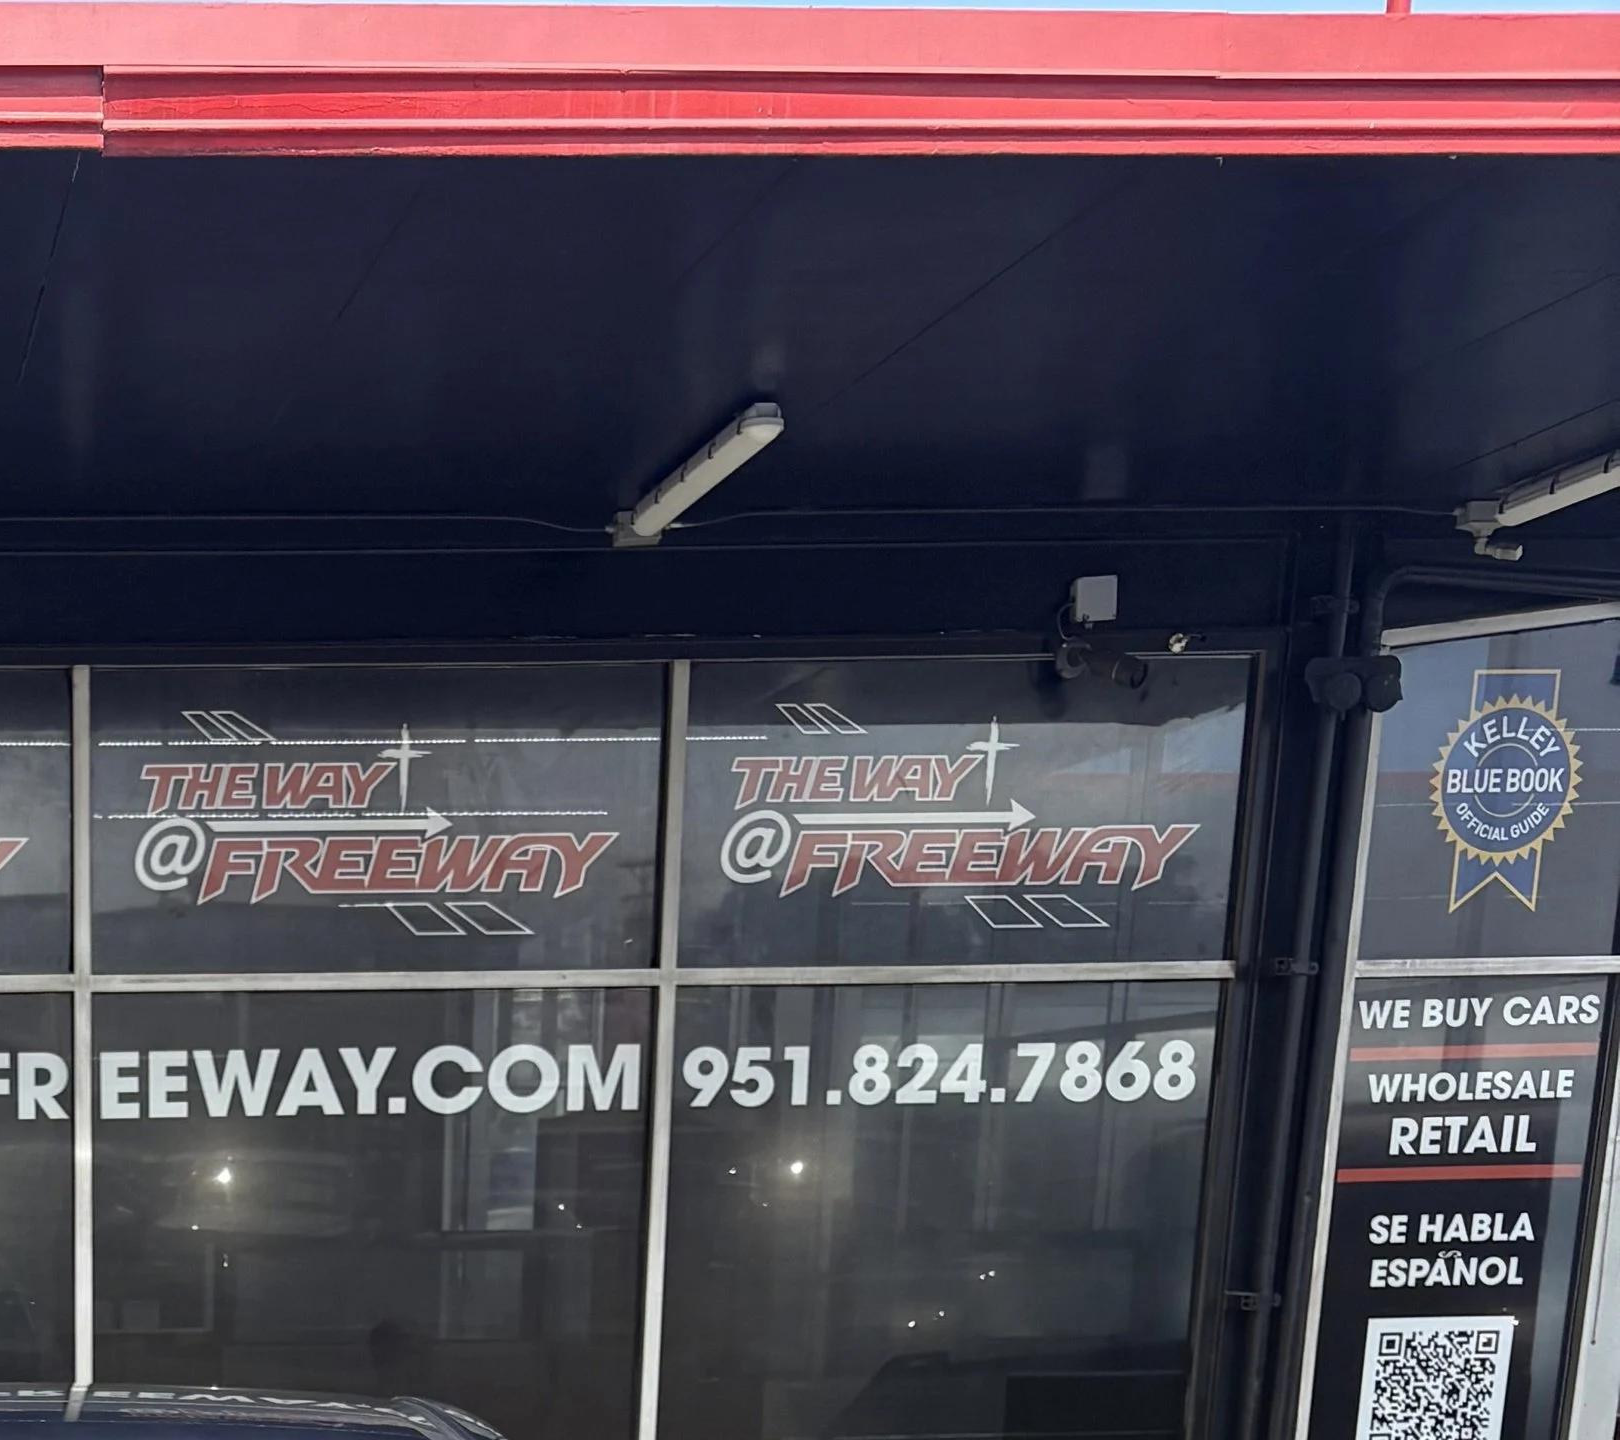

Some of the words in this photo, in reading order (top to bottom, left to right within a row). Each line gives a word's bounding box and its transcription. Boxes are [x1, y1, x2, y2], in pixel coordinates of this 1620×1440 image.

[1463, 715, 1561, 758] KELLEY
[1446, 768, 1503, 794] BLUE
[1505, 767, 1565, 793] BOOK
[1456, 802, 1509, 841] OFFICIAL
[1509, 802, 1550, 838] GUIDE
[1359, 1000, 1412, 1029] WE
[1421, 997, 1494, 1028] BUY
[1502, 994, 1601, 1026] CARS
[682, 1040, 1197, 1108] 951.824.7868
[1367, 1069, 1575, 1103] WHOLESALE
[1389, 1114, 1537, 1156] RETAIL
[1368, 1214, 1409, 1245] SE
[1417, 1212, 1535, 1243] HABLA
